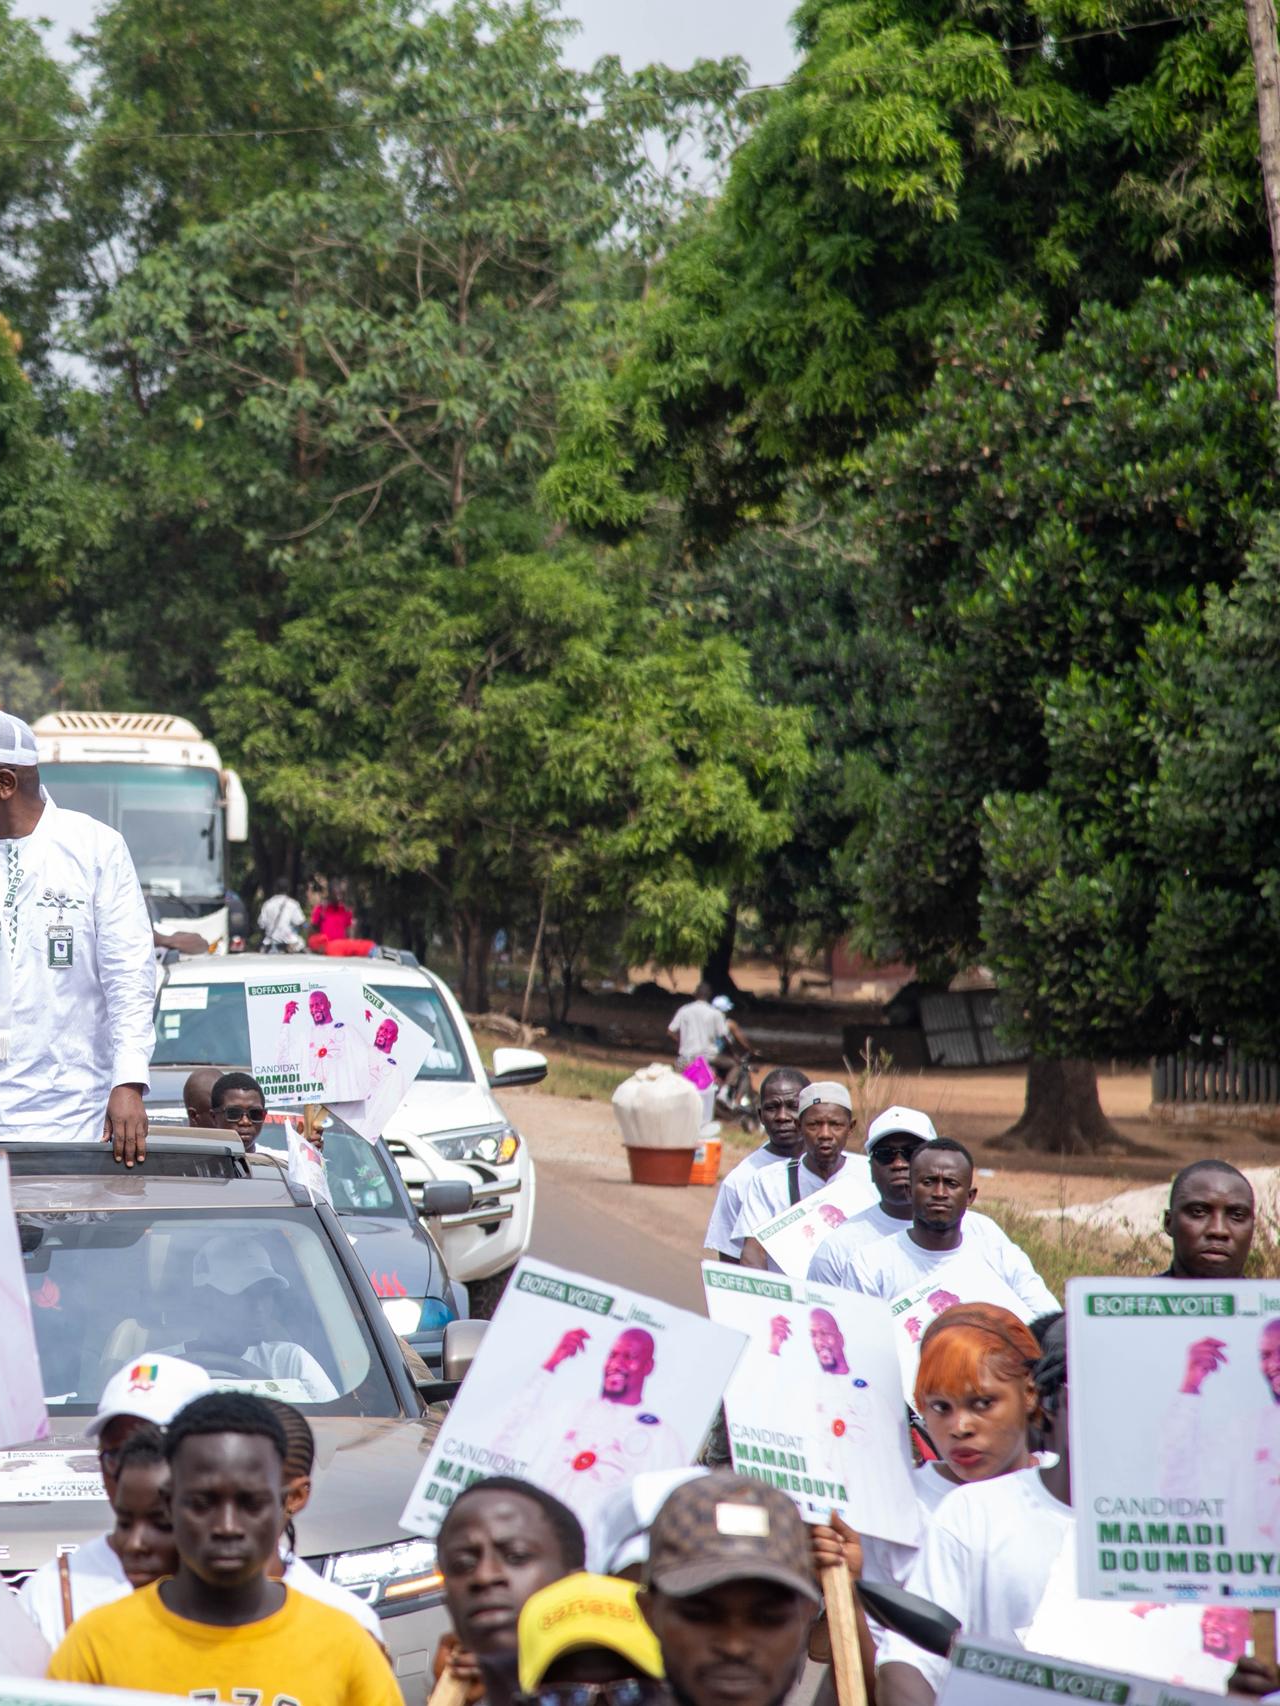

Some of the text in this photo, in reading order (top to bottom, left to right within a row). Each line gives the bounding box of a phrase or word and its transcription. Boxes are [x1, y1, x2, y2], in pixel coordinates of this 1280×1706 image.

[252, 984, 298, 995] BOFFA VOTE
[364, 990, 381, 1008] VOTE
[254, 1064, 300, 1074] CANDIDAT
[256, 1073, 300, 1085] MAMADI
[263, 1082, 324, 1095] OUMBOUYA
[520, 1273, 610, 1314] BOFFA VOTE
[709, 1271, 790, 1300] BOFFA VOTE
[1093, 1297, 1225, 1315] BOFFA VOTE
[730, 1422, 804, 1449] CANDIDAT
[443, 1438, 527, 1475] CANDIDAT
[735, 1442, 807, 1472] MAMADI
[435, 1459, 484, 1487] MAM
[738, 1463, 849, 1501] DOUMBOUYA
[1094, 1496, 1224, 1518] CANDIDAT
[1098, 1522, 1226, 1545] MAMADI
[1099, 1549, 1280, 1574] DOUMBOUY
[963, 1651, 1119, 1701] BOFFA VOTE
